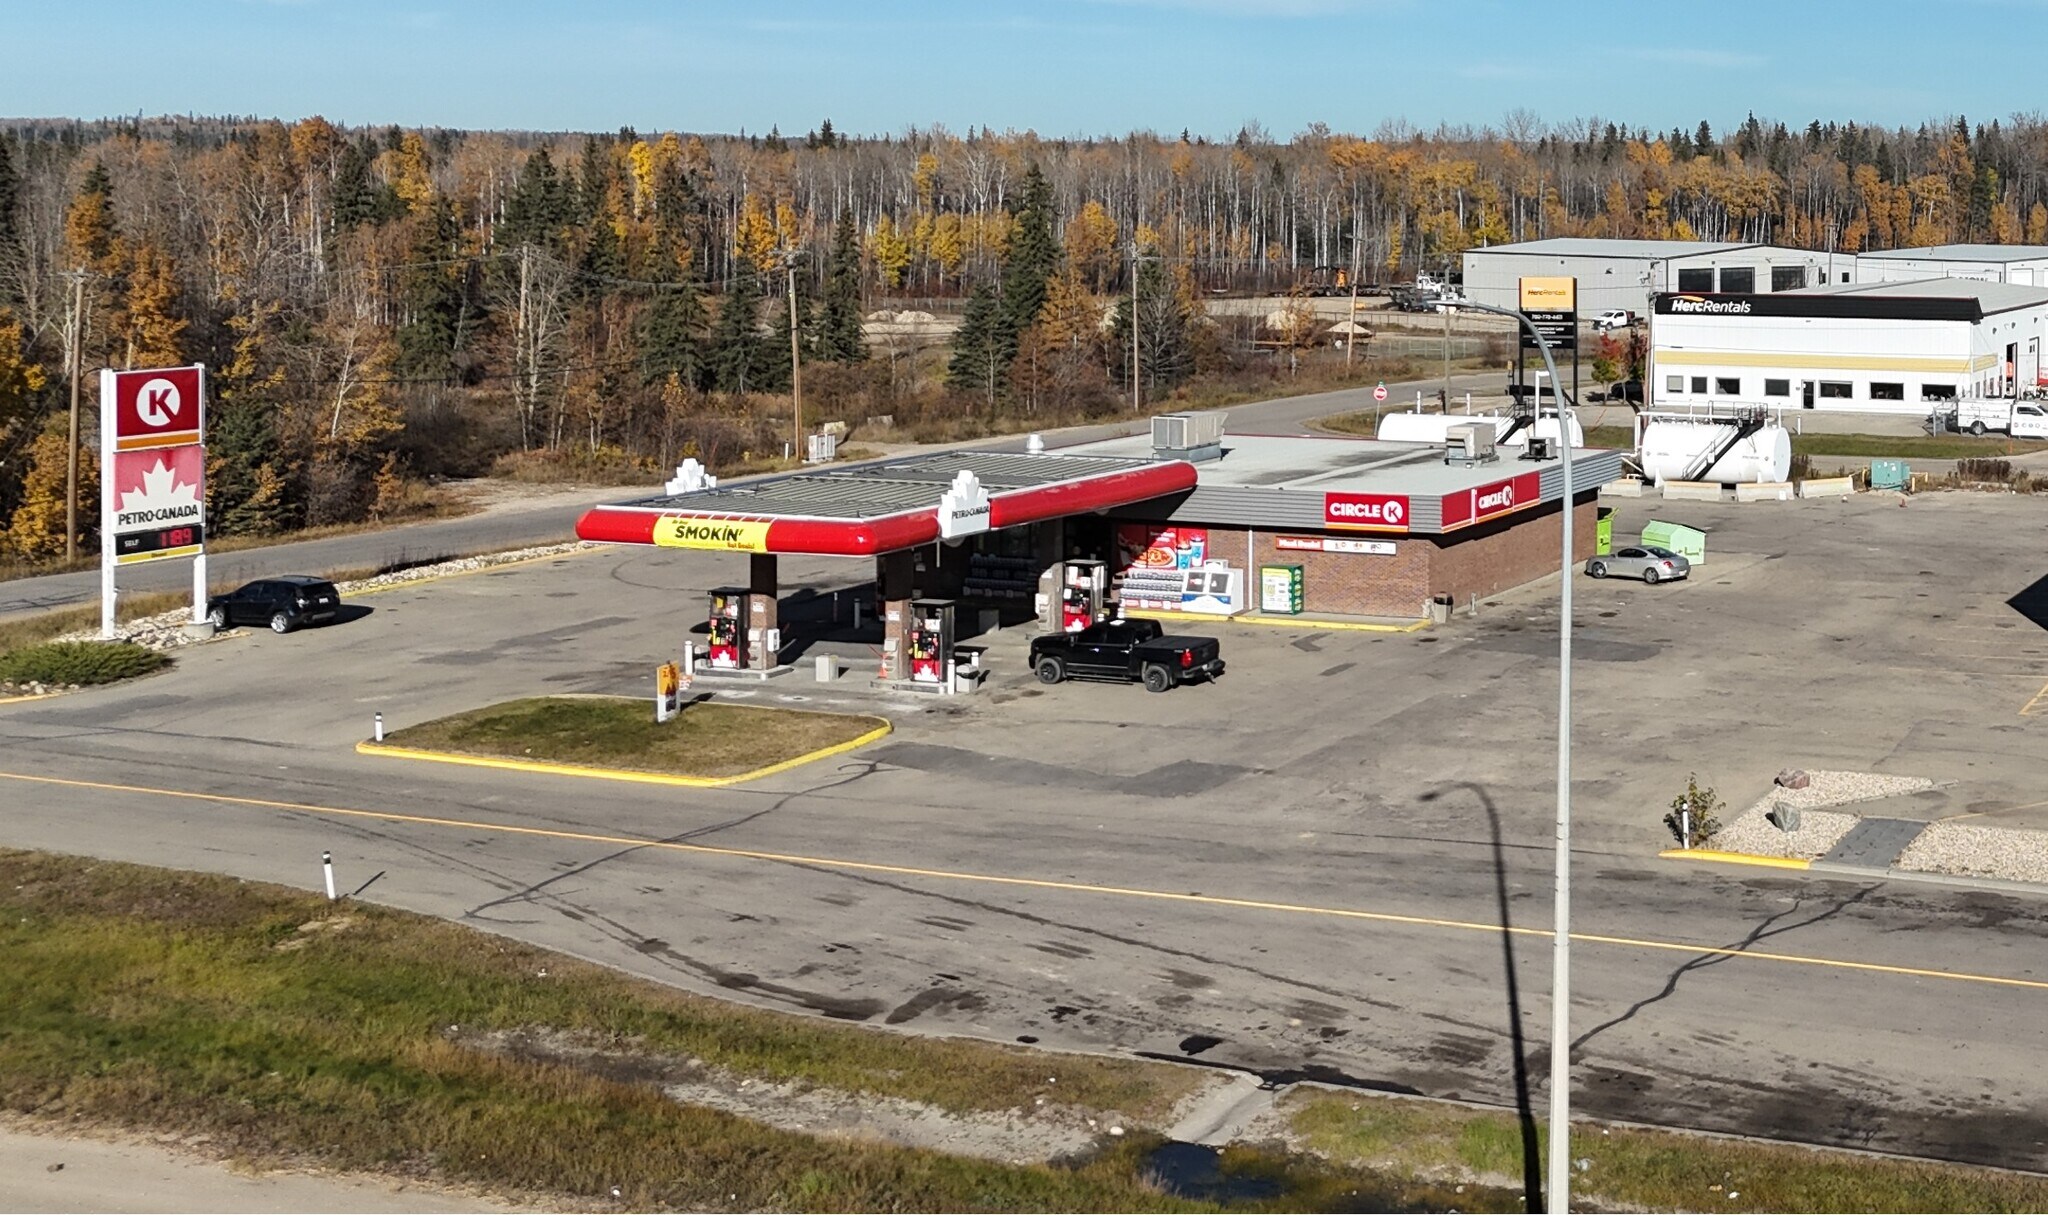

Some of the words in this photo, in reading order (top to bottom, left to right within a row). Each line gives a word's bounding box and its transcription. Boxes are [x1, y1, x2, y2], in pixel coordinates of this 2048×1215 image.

[1671, 299, 1752, 313] HercRentals
[1478, 491, 1503, 509] CIRCLE
[118, 504, 199, 526] PETRO-CANADA
[1329, 502, 1381, 518] CIRCLE
[1384, 502, 1403, 523] K
[124, 539, 140, 547] SELF
